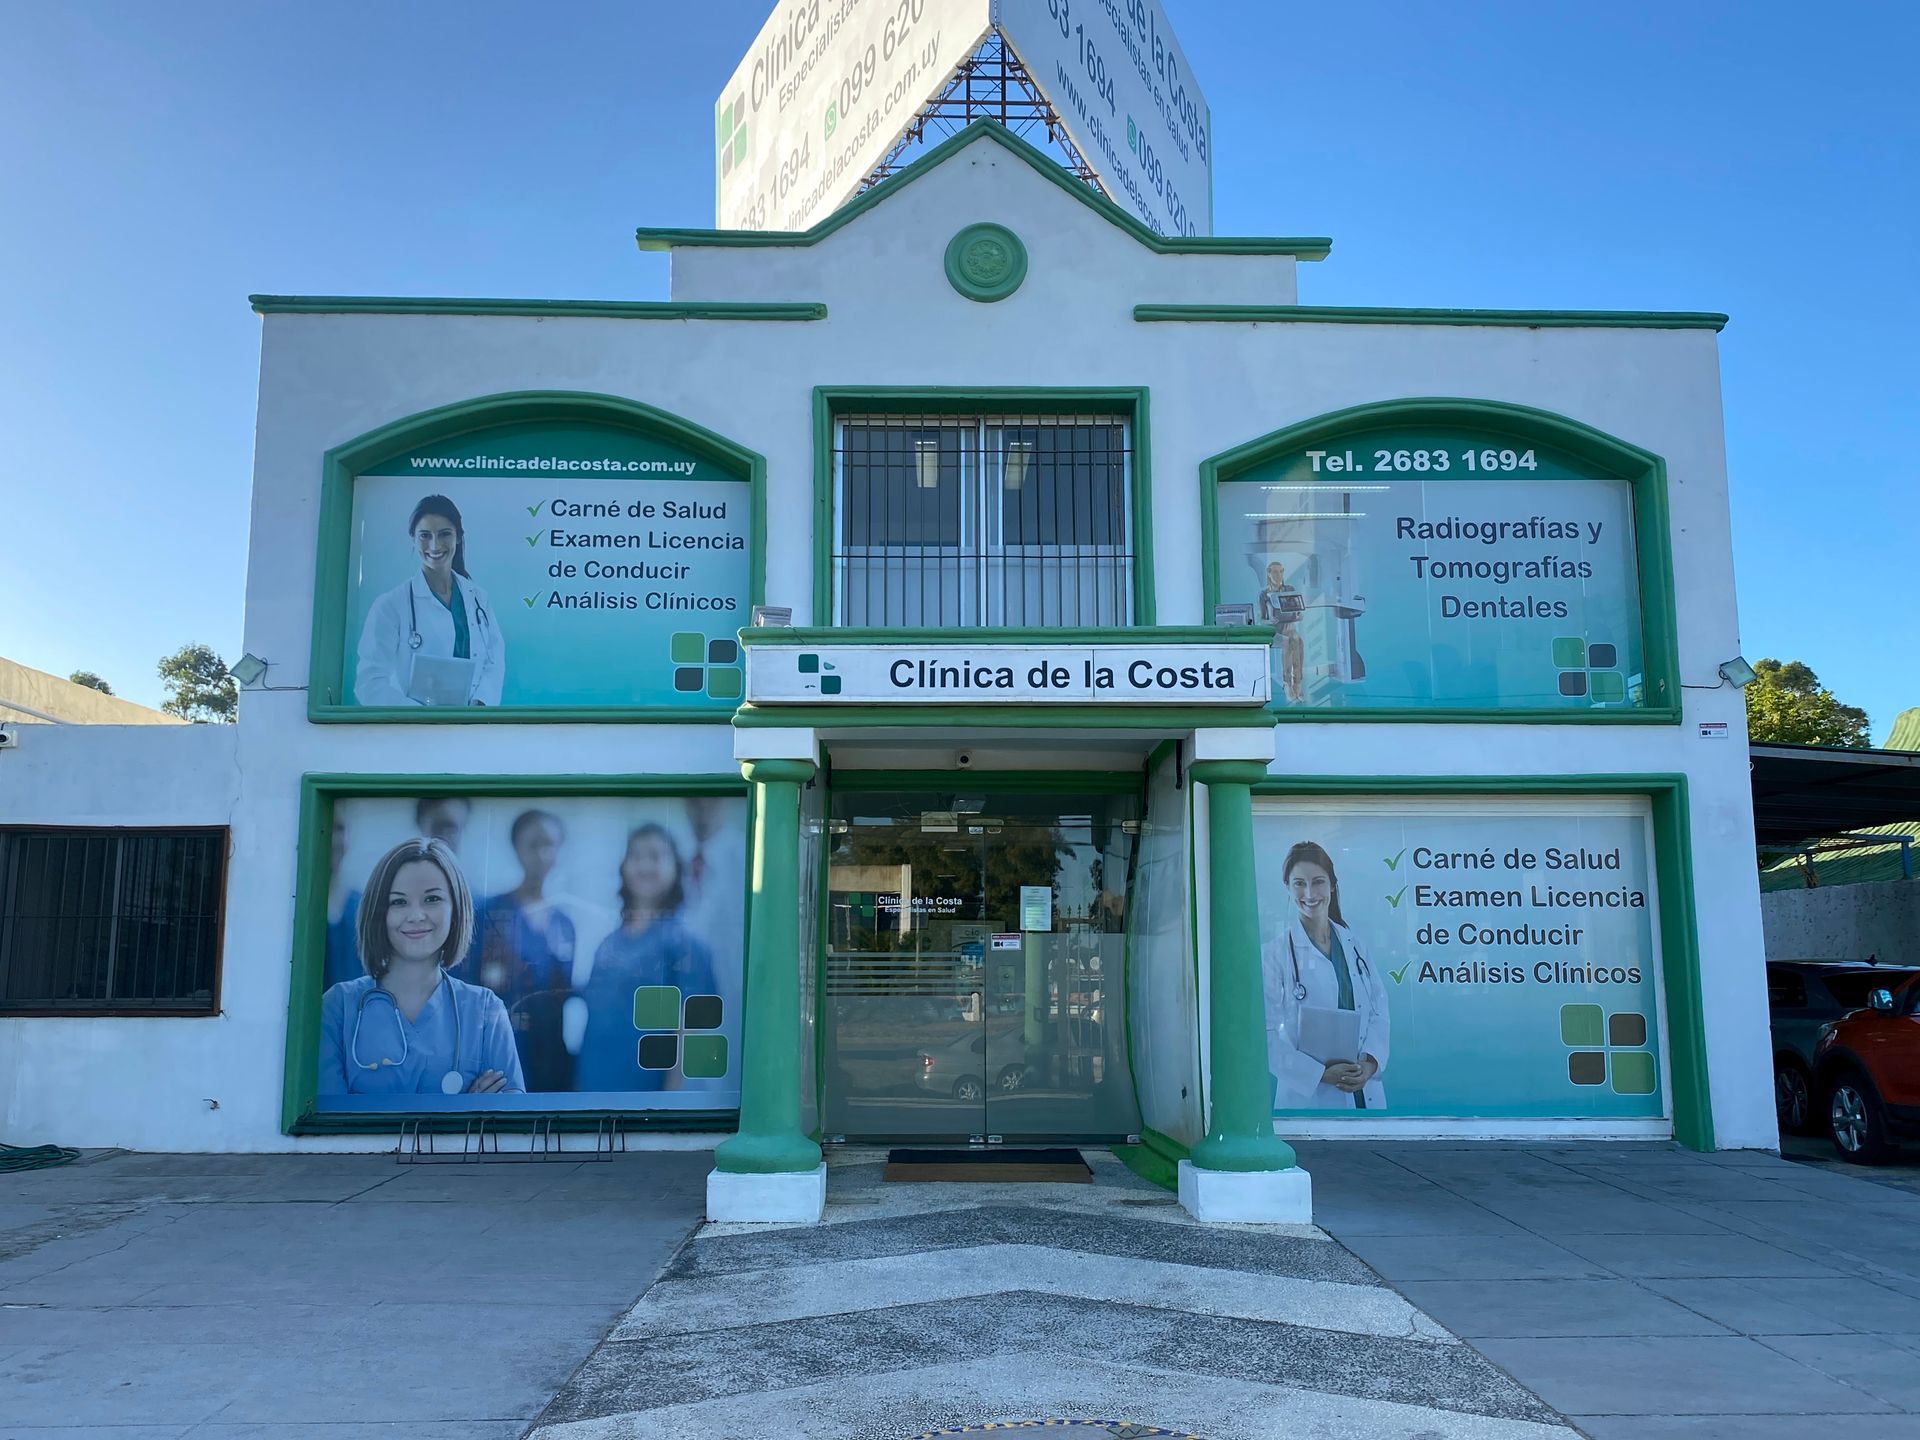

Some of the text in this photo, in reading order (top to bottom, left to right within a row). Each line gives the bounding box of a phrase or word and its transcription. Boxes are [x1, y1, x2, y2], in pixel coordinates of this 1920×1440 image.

[751, 0, 819, 112] Clínica
[780, 0, 859, 113] Especialista
[840, 43, 876, 119] 099
[1076, 23, 1116, 118] 1694
[1150, 9, 1165, 82] la
[1168, 51, 1207, 167] Costa
[784, 30, 940, 232] linicadelacosta.com.uy
[1154, 86, 1165, 118] en
[1166, 104, 1189, 165] Salud
[770, 130, 810, 211] 1694
[1139, 131, 1187, 237] 099 620
[410, 456, 696, 475] www.clinicadelacosta.com.uy
[1306, 449, 1538, 472] Tel. 2683 1694
[551, 499, 727, 520] Carné de Salud
[549, 530, 745, 550] Examen Licencia
[1396, 517, 1603, 545] Radiografías y
[548, 560, 690, 580] de Conducir
[1410, 556, 1593, 584] Tomografías
[547, 591, 737, 611] Análisis Clínicos
[1441, 595, 1568, 618] Dentales
[889, 659, 1235, 689] Clínica de la Costa
[1412, 847, 1621, 870] Carné de Salud
[878, 896, 963, 905] Clínic de la Costa
[1415, 885, 1645, 908] Examen Licencia
[1416, 923, 1583, 945] de Conducir
[1417, 961, 1642, 984] Análisis Clínicos
